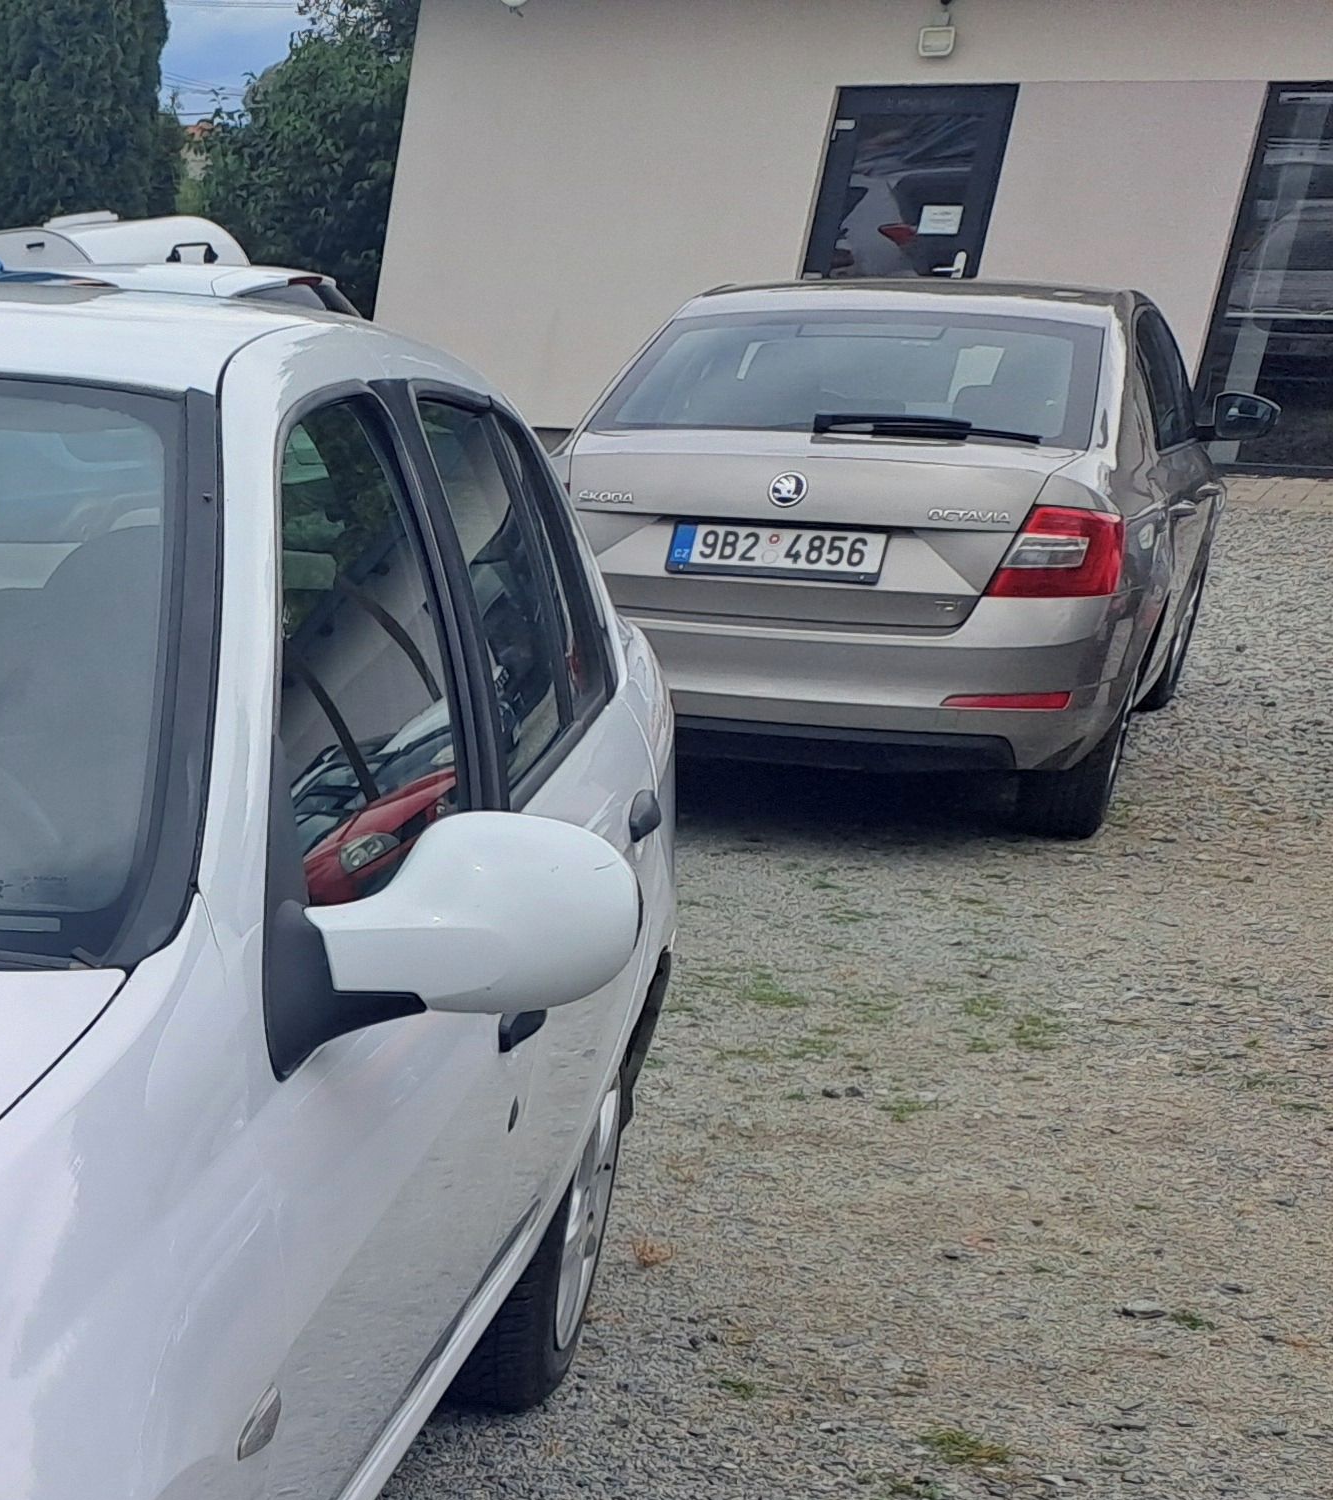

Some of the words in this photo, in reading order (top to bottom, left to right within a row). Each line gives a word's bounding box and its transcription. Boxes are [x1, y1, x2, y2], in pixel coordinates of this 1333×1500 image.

[927, 508, 1011, 524] OCTAVIA
[674, 548, 690, 558] CZ
[699, 530, 761, 562] 9B2
[784, 533, 868, 567] 4856
